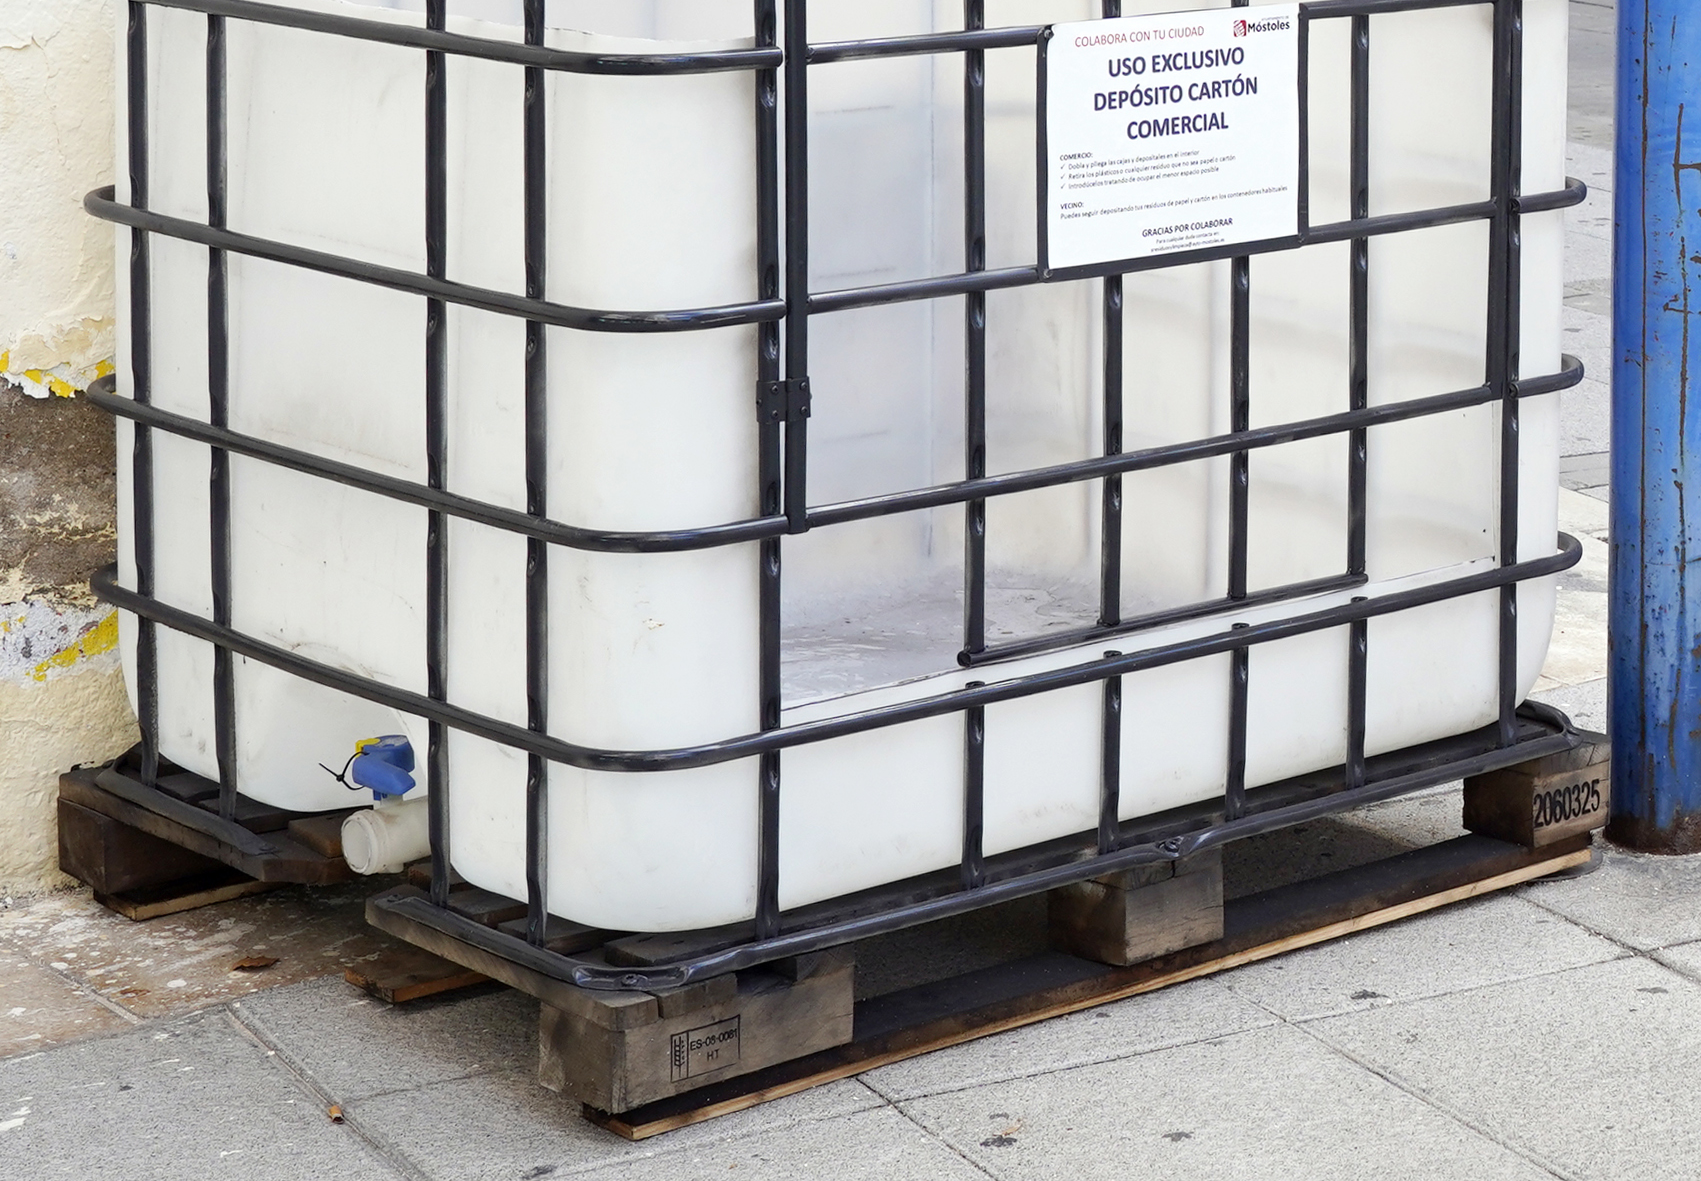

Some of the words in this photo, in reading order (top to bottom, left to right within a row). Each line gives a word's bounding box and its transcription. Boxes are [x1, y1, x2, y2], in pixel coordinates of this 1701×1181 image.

[1075, 33, 1127, 47] COLABORA
[1129, 31, 1150, 42] CON
[1153, 29, 1166, 40] TU
[1168, 26, 1204, 39] CIUDAD
[1247, 20, 1290, 34] Móstoles
[1108, 56, 1146, 77] USO
[1152, 47, 1245, 73] EXCLUSIVO
[1094, 83, 1183, 111] DEPÓSITO
[1188, 73, 1258, 101] CARTÓN
[1127, 112, 1229, 140] COMERCIAL
[1068, 162, 1085, 170] Dobla
[1068, 172, 1085, 180] Retira
[1200, 156, 1214, 165] papel
[1060, 212, 1081, 220] Puedes
[1175, 197, 1189, 206] papel
[1142, 225, 1173, 237] GRACIAS
[1175, 223, 1189, 233] POR
[1190, 217, 1234, 231] COLABORAR
[1533, 779, 1601, 828] 2060325
[707, 1049, 719, 1062] HT
